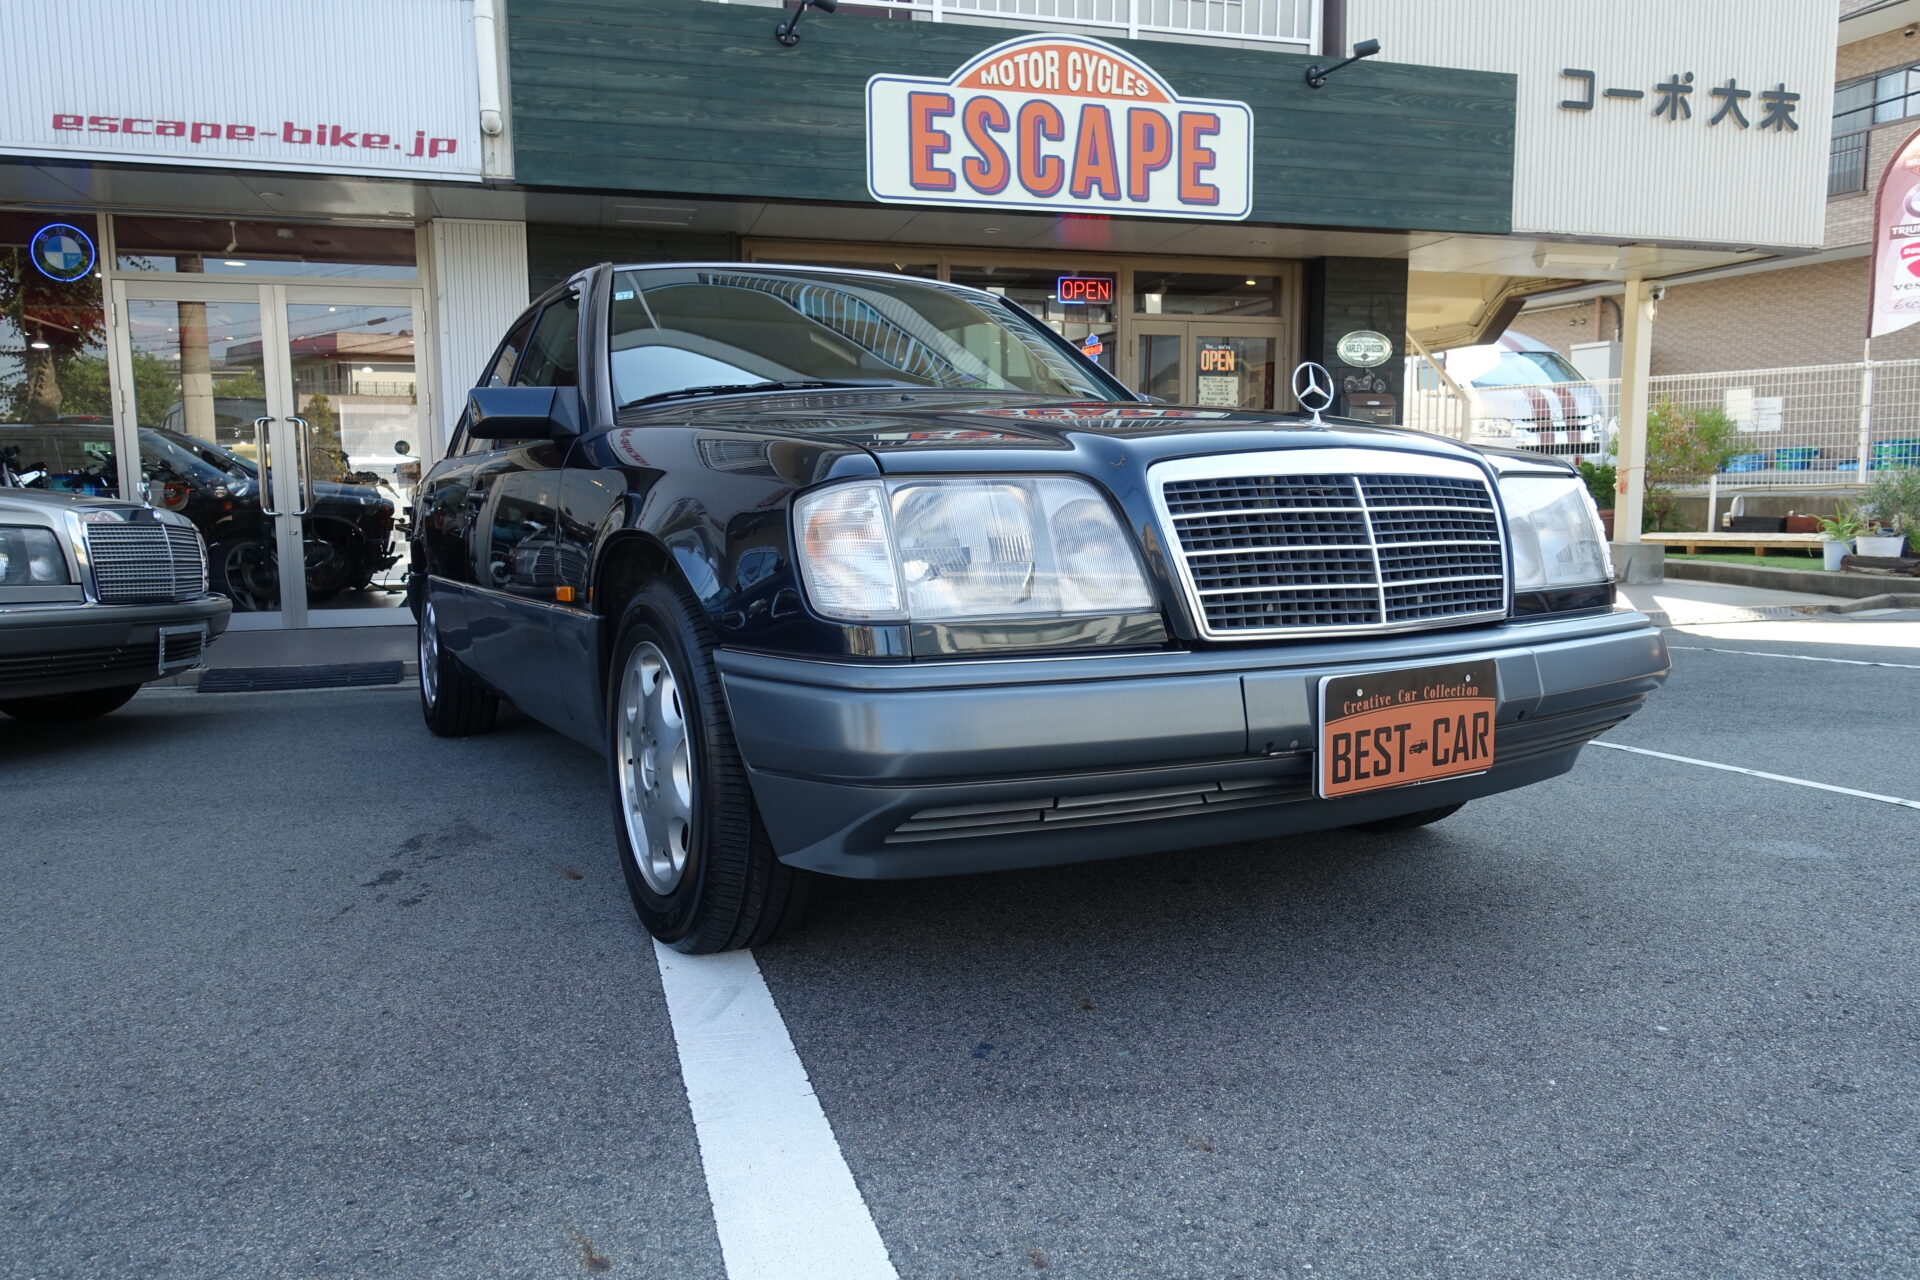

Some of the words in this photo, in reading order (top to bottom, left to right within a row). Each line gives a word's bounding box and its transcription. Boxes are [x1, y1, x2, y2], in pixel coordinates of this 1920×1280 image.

[980, 50, 1059, 91] MOTOR
[1067, 51, 1150, 97] CYCLES
[1560, 67, 1801, 133] コーポ大末
[53, 113, 457, 158] escape-bike.jp
[908, 90, 1221, 206] ESCAPE
[1062, 280, 1109, 300] OPEN
[1200, 350, 1235, 371] OPEN
[1343, 694, 1391, 715] Creative
[1398, 689, 1417, 703] Car
[1424, 683, 1478, 699] Collection
[1332, 723, 1411, 784] BEST
[1432, 711, 1489, 767] CAR
